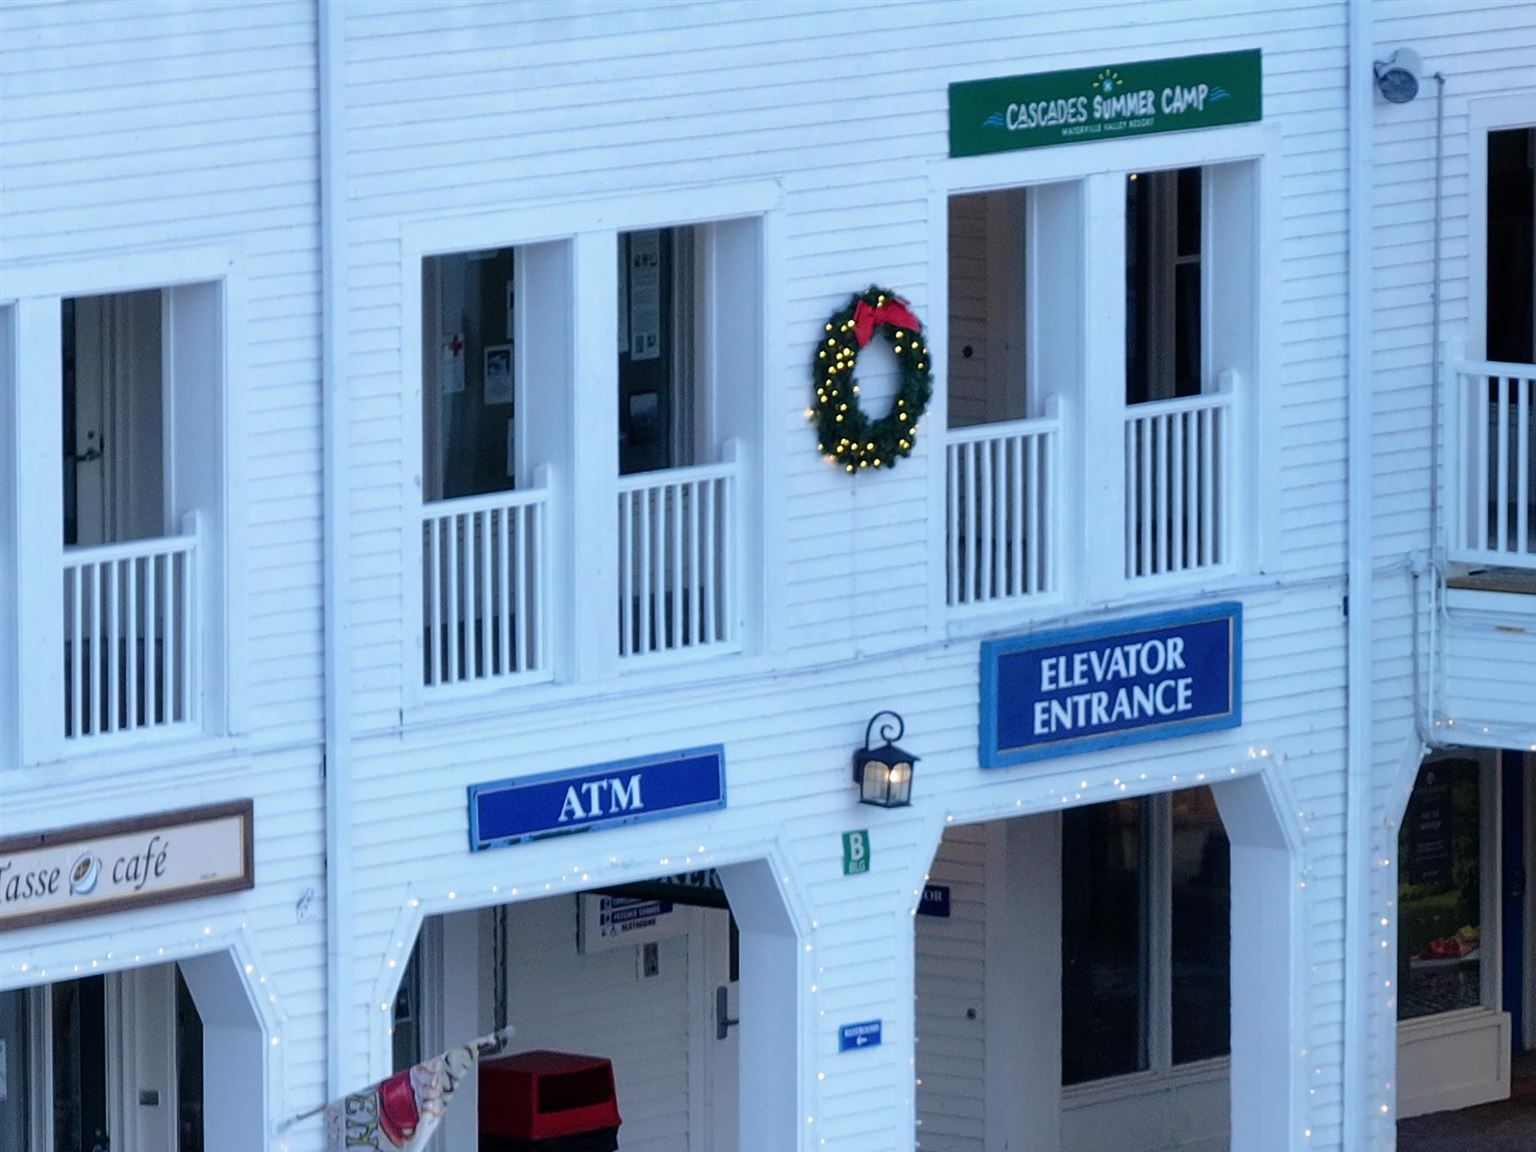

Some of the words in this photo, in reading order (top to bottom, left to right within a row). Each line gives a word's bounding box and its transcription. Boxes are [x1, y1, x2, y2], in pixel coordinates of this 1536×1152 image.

[1006, 95, 1088, 131] CASCADES
[1093, 89, 1155, 120] SUMMER
[1161, 83, 1209, 115] CAMP
[1103, 119, 1127, 131] VALLEY
[1129, 117, 1154, 129] RESORT
[1040, 636, 1186, 693] ELEVATOR
[1033, 677, 1193, 736] ENTRANCE
[558, 773, 645, 822] ATM
[112, 835, 169, 891] café
[849, 832, 865, 861] B
